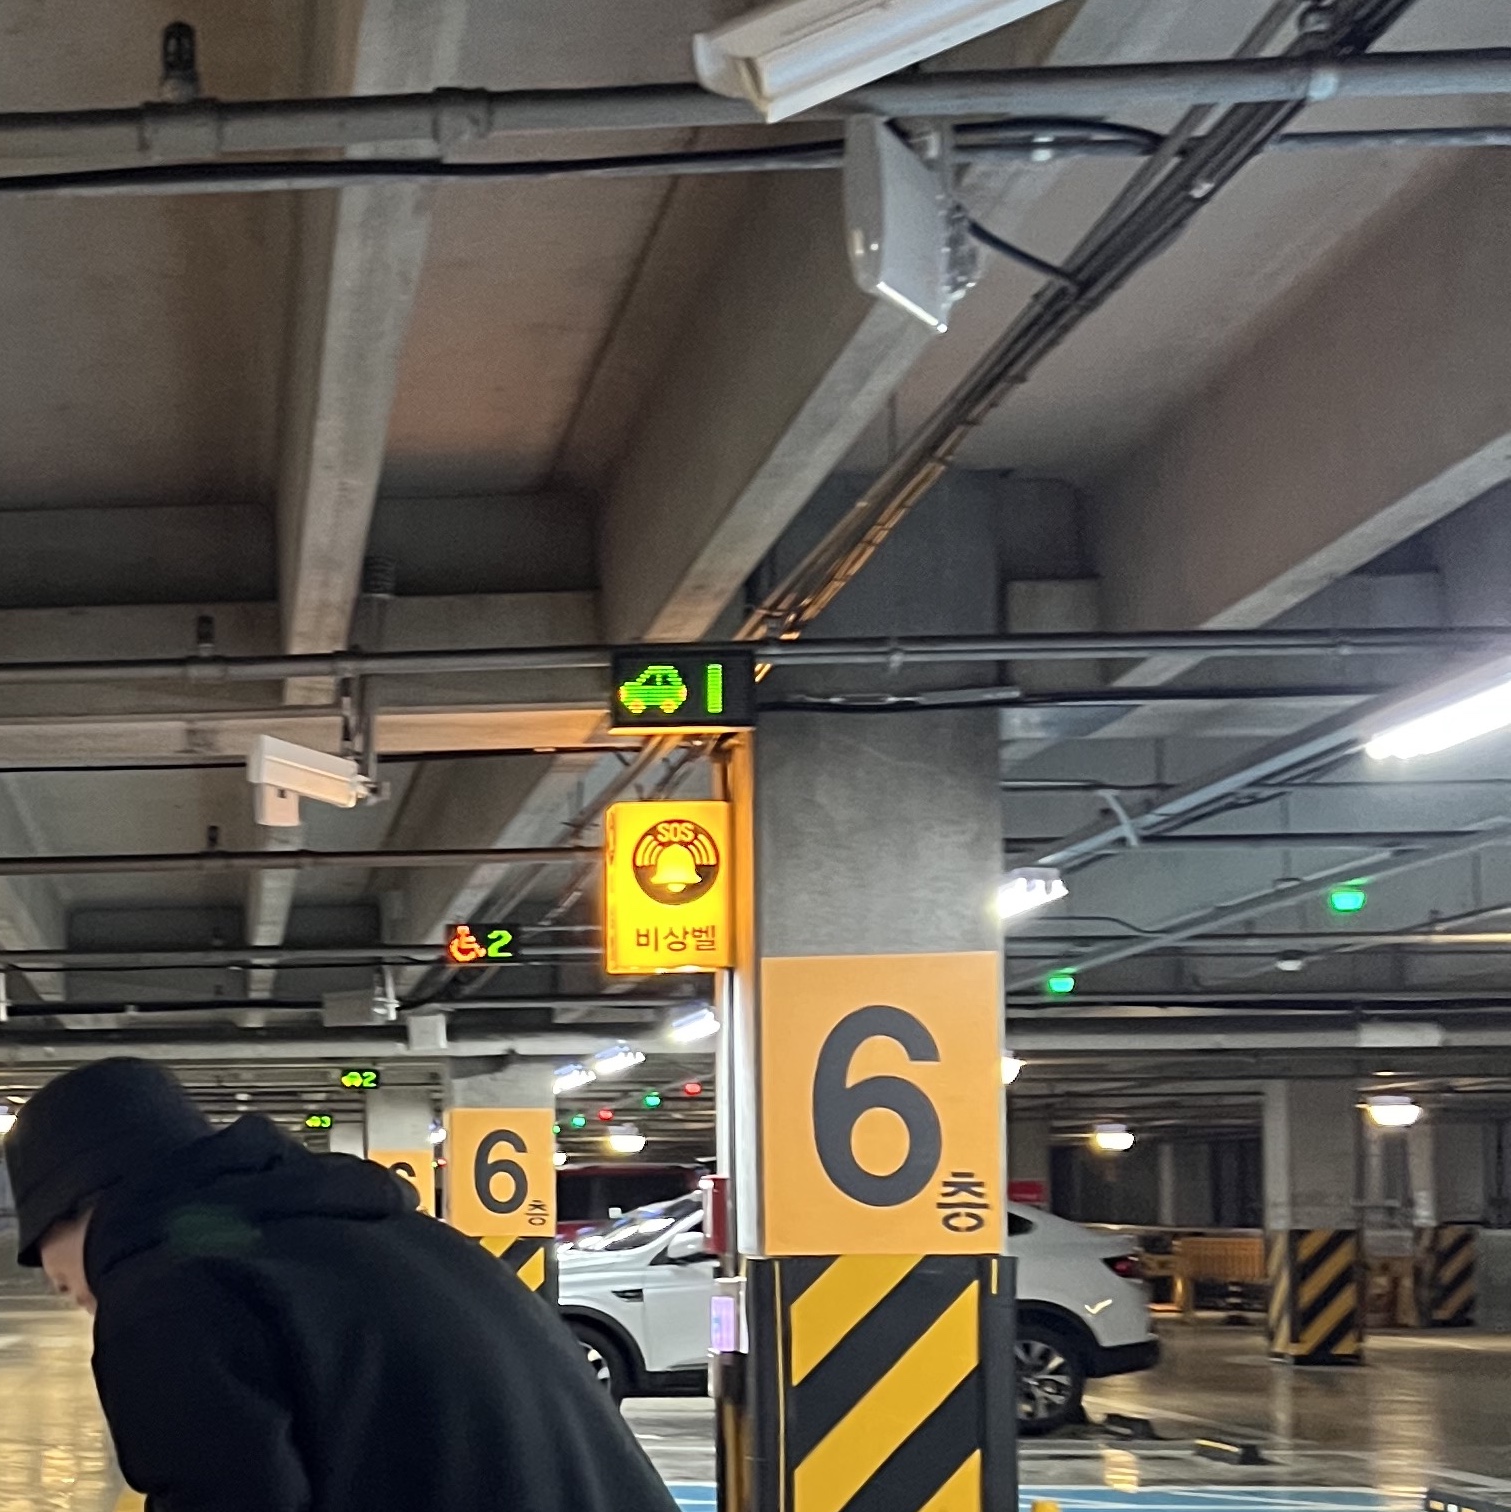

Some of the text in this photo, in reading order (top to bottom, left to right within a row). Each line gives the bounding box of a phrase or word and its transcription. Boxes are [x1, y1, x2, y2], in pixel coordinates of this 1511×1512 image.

[656, 821, 697, 843] SOS
[488, 930, 513, 957] 2
[635, 925, 718, 952] 비상벨
[362, 1071, 377, 1087] 2
